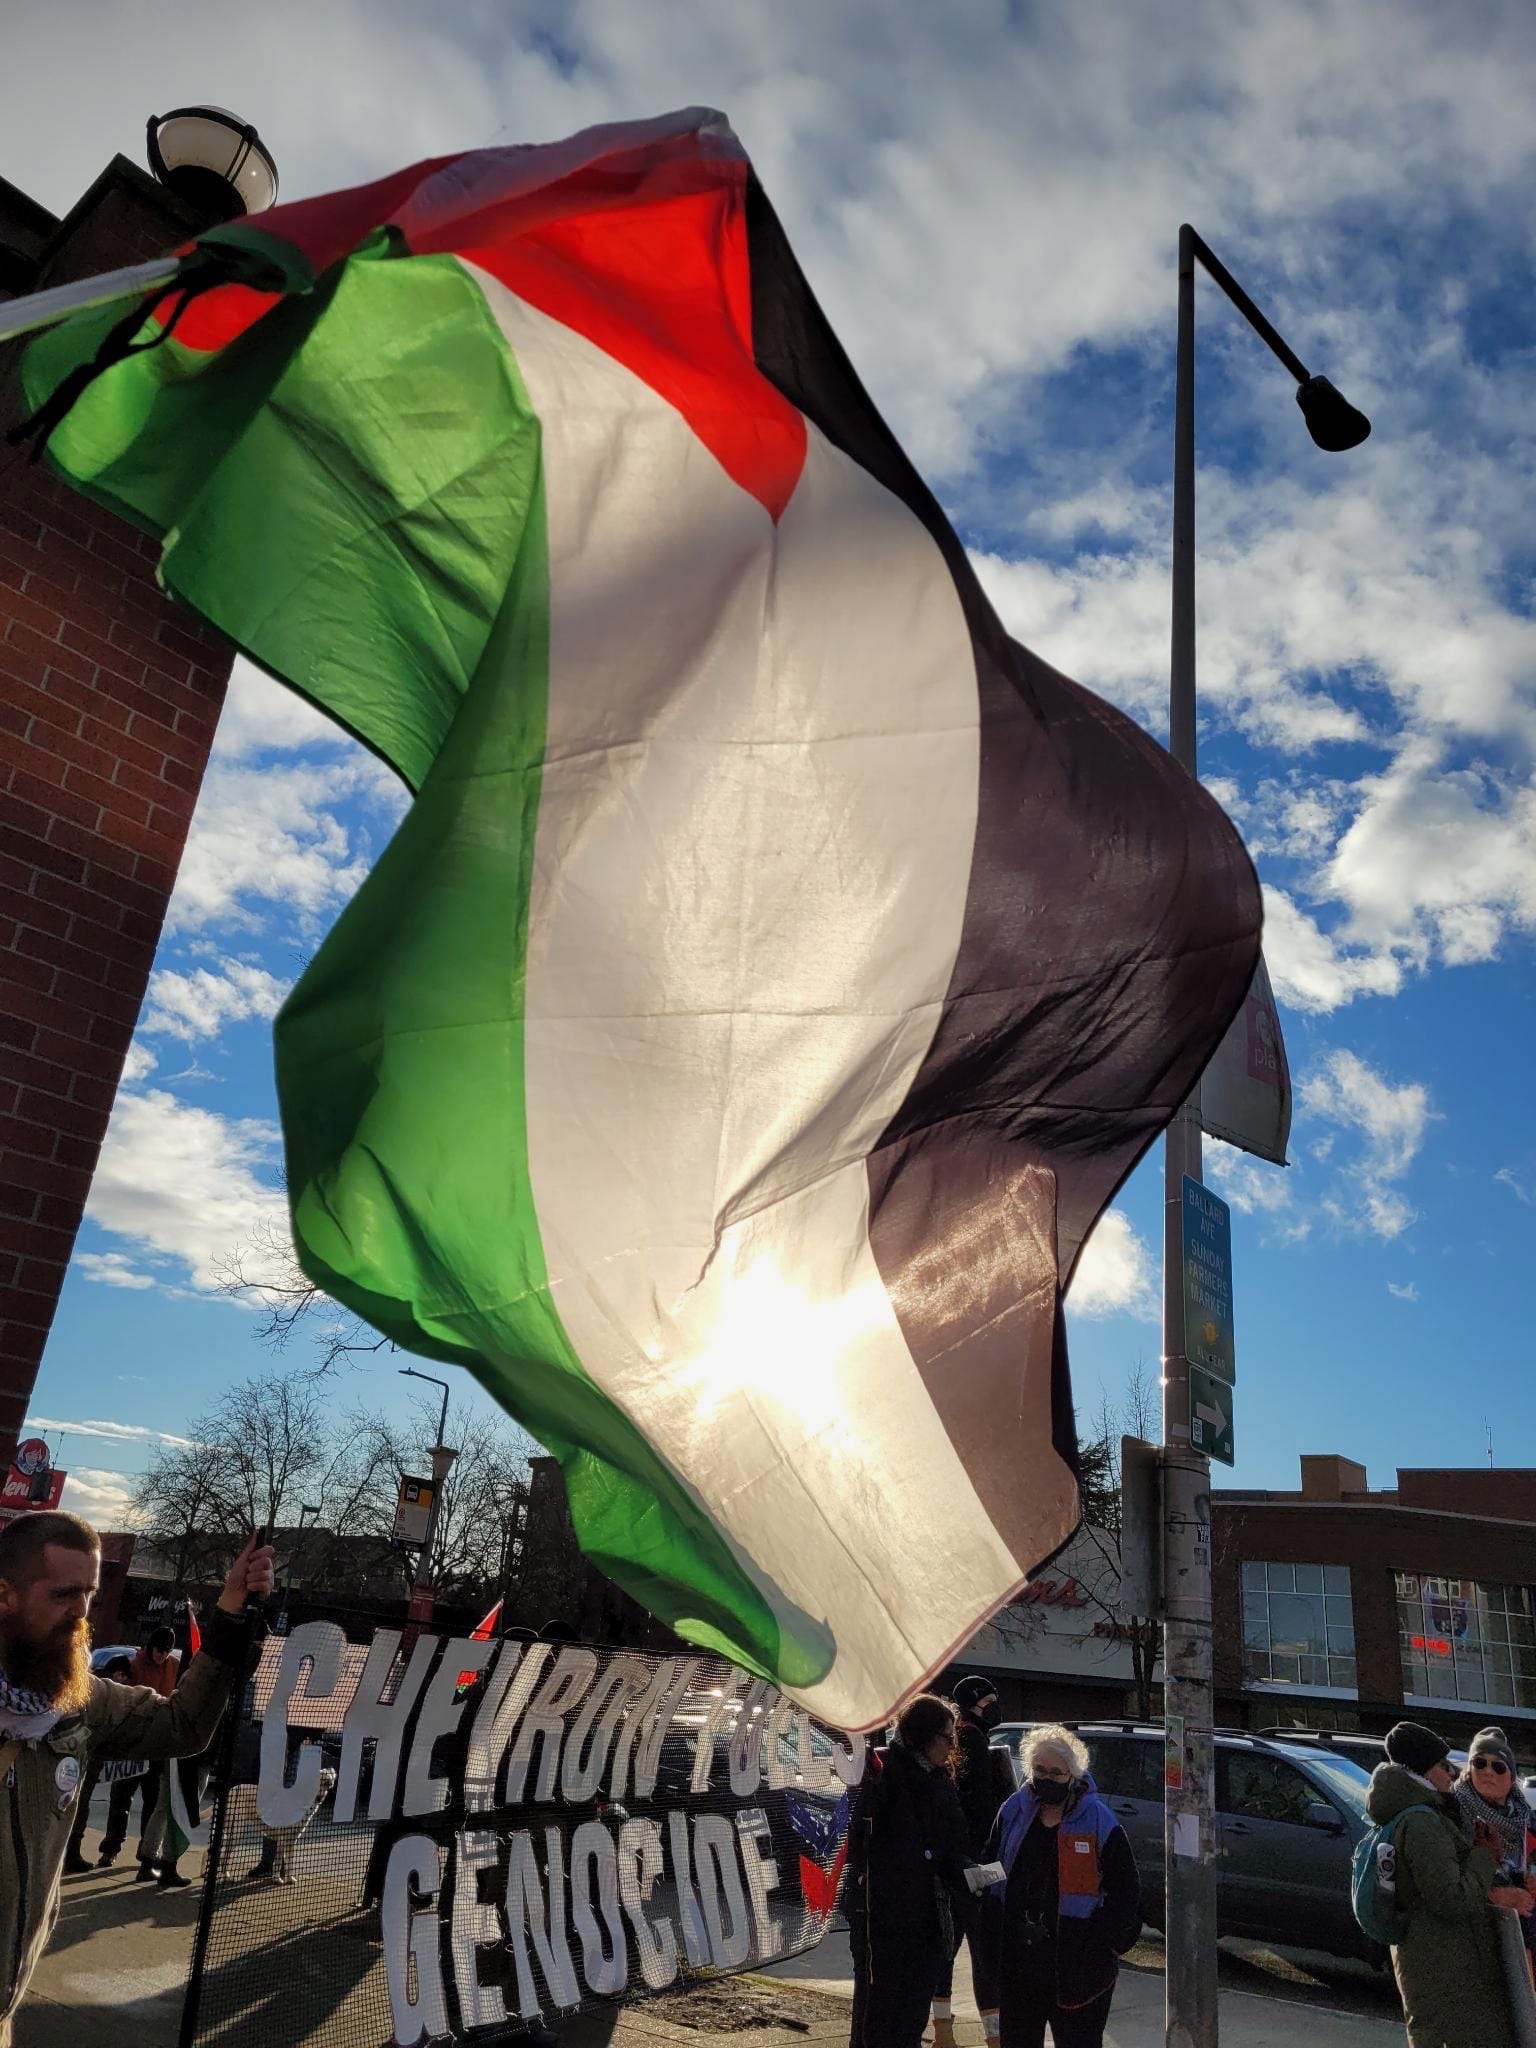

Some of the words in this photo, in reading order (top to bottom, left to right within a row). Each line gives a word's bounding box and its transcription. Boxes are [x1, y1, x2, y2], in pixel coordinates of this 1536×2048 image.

[1189, 1188, 1225, 1226] BALLARD
[1200, 1216, 1216, 1241] AVE
[1191, 1238, 1225, 1273] SUNDAY
[1188, 1259, 1230, 1298] FARMERS
[1190, 1282, 1228, 1319] MARKET
[256, 1620, 700, 1827] CHEVRON
[382, 1808, 782, 2046] GENOCIDE
